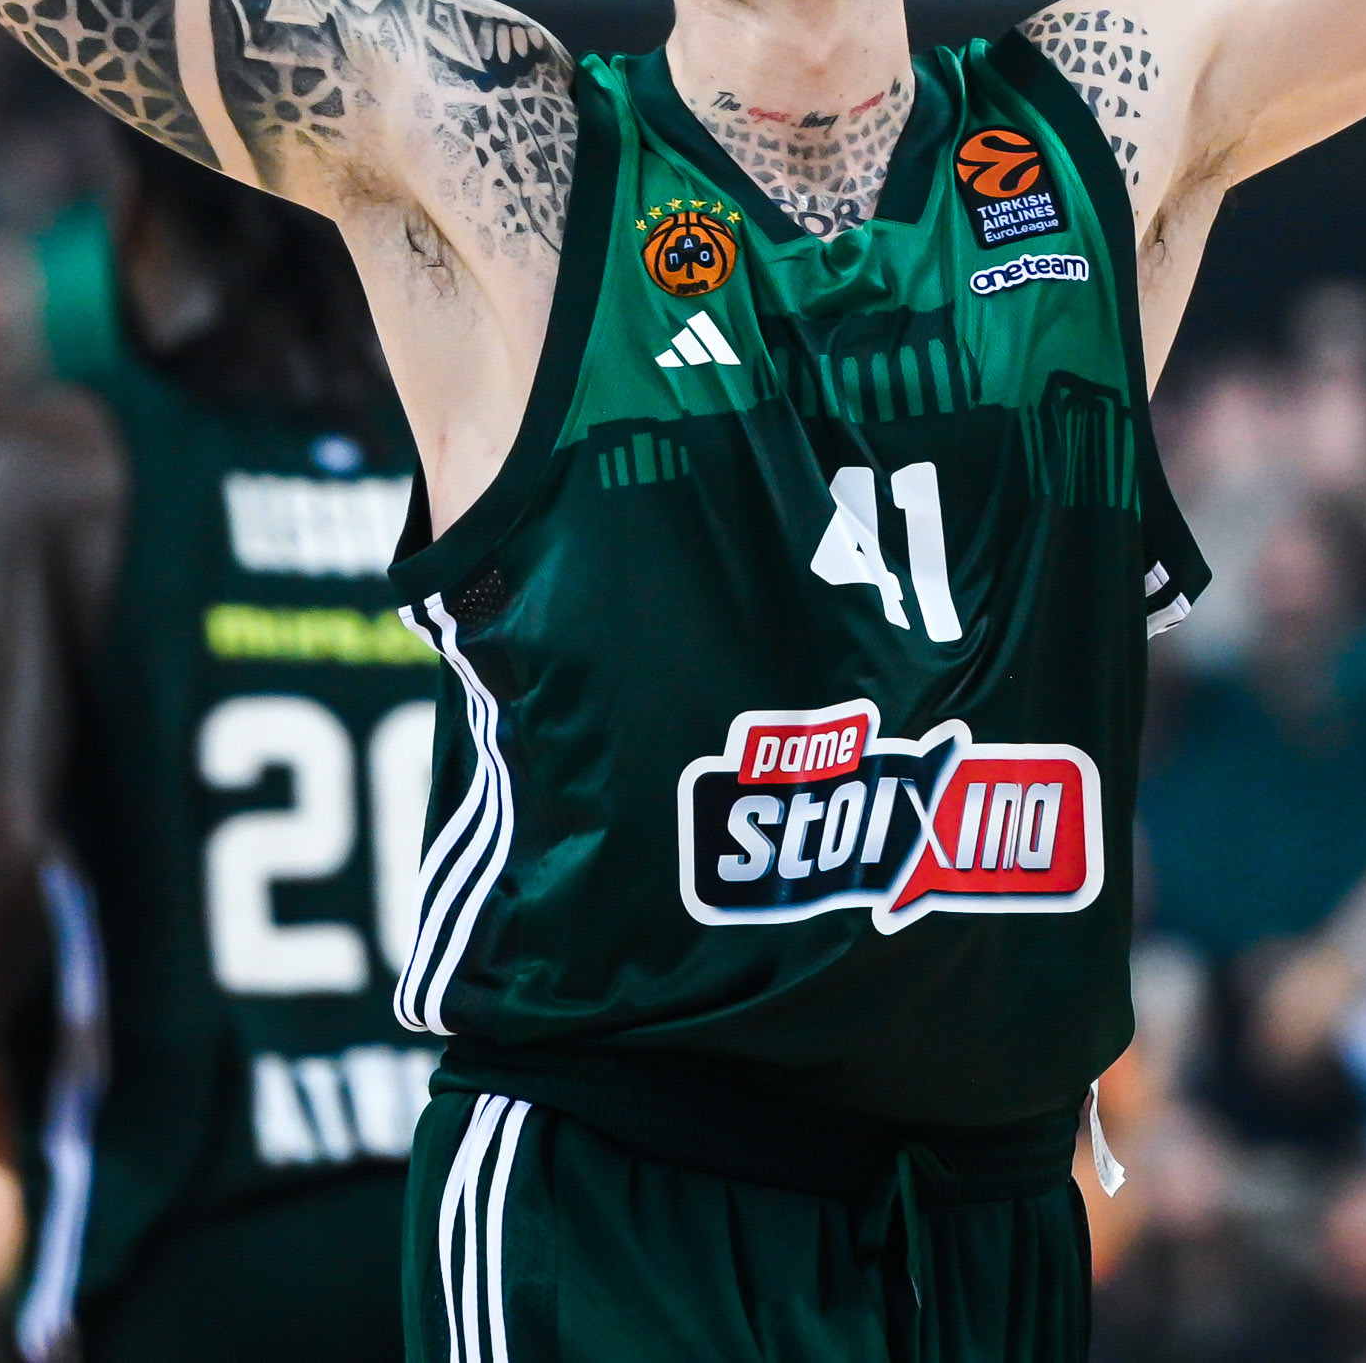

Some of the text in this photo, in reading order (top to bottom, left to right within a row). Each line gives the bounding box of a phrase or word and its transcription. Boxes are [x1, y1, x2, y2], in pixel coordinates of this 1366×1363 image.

[976, 192, 1052, 219] TURKISH
[983, 205, 1056, 232] AIRLINES
[984, 219, 1059, 243] EuroLeague
[810, 461, 964, 643] 41
[750, 725, 858, 779] pame
